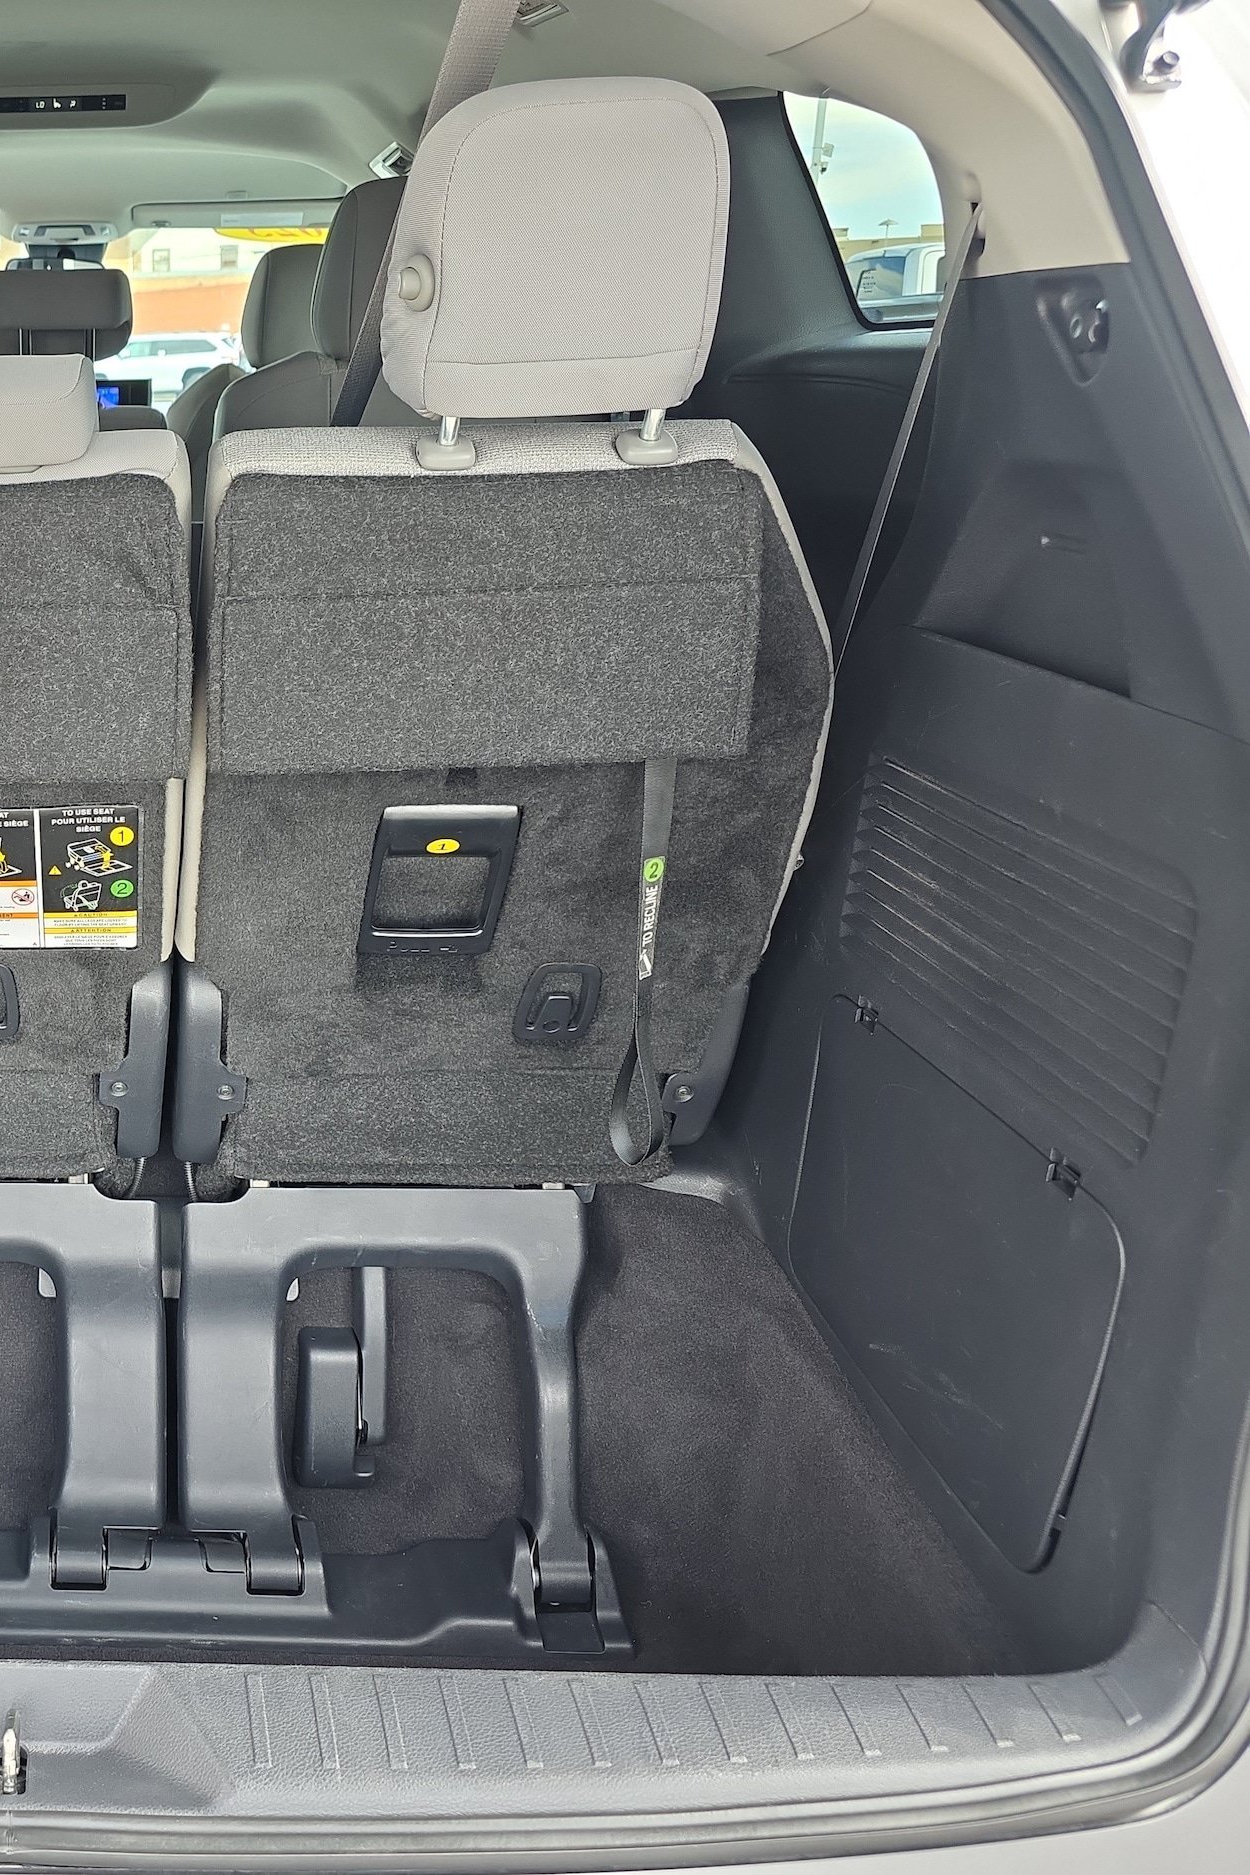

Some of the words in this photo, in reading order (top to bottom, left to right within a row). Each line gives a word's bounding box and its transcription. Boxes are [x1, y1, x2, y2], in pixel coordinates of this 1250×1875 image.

[62, 809, 74, 817] TO
[75, 808, 92, 816] USE
[3, 819, 29, 827] SIÈGE
[51, 818, 75, 826] POUR
[75, 816, 114, 824] UTILISER
[75, 824, 102, 833] SIÈGE
[649, 862, 659, 878] 2
[116, 883, 128, 895] 2
[644, 885, 658, 929] RECLINE
[642, 930, 654, 946] TO
